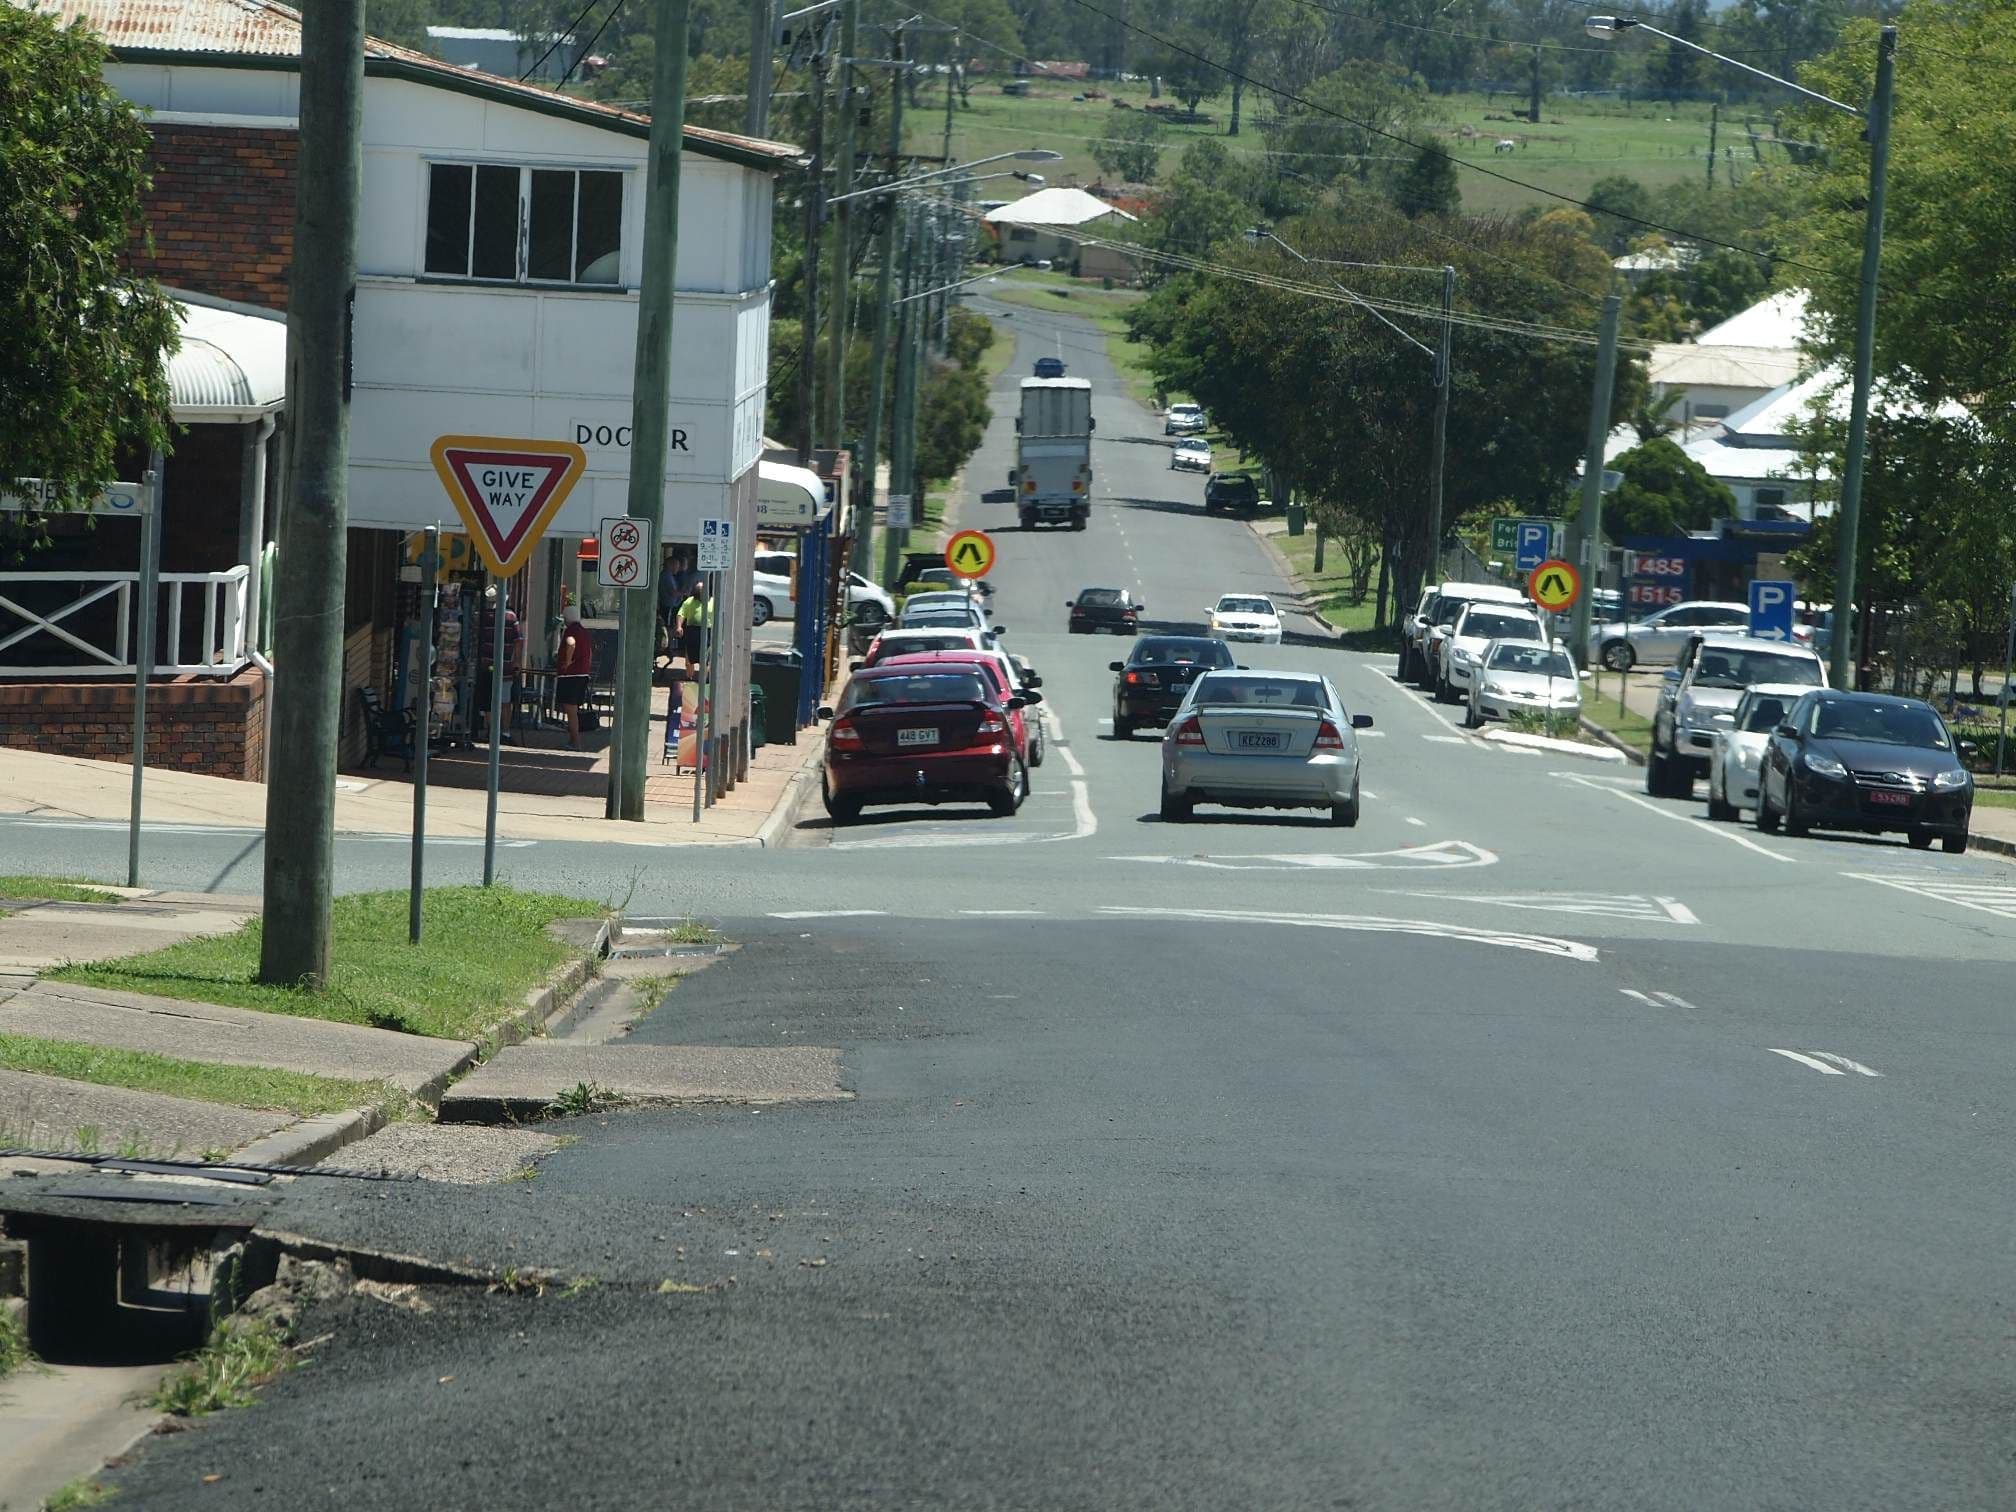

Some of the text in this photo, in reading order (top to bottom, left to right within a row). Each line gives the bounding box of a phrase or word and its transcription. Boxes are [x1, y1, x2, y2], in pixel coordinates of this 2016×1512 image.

[576, 424, 689, 451] DOCR
[482, 470, 535, 489] GIVE
[489, 492, 526, 508] WAY
[1524, 528, 1542, 546] P
[1759, 586, 1784, 614] P
